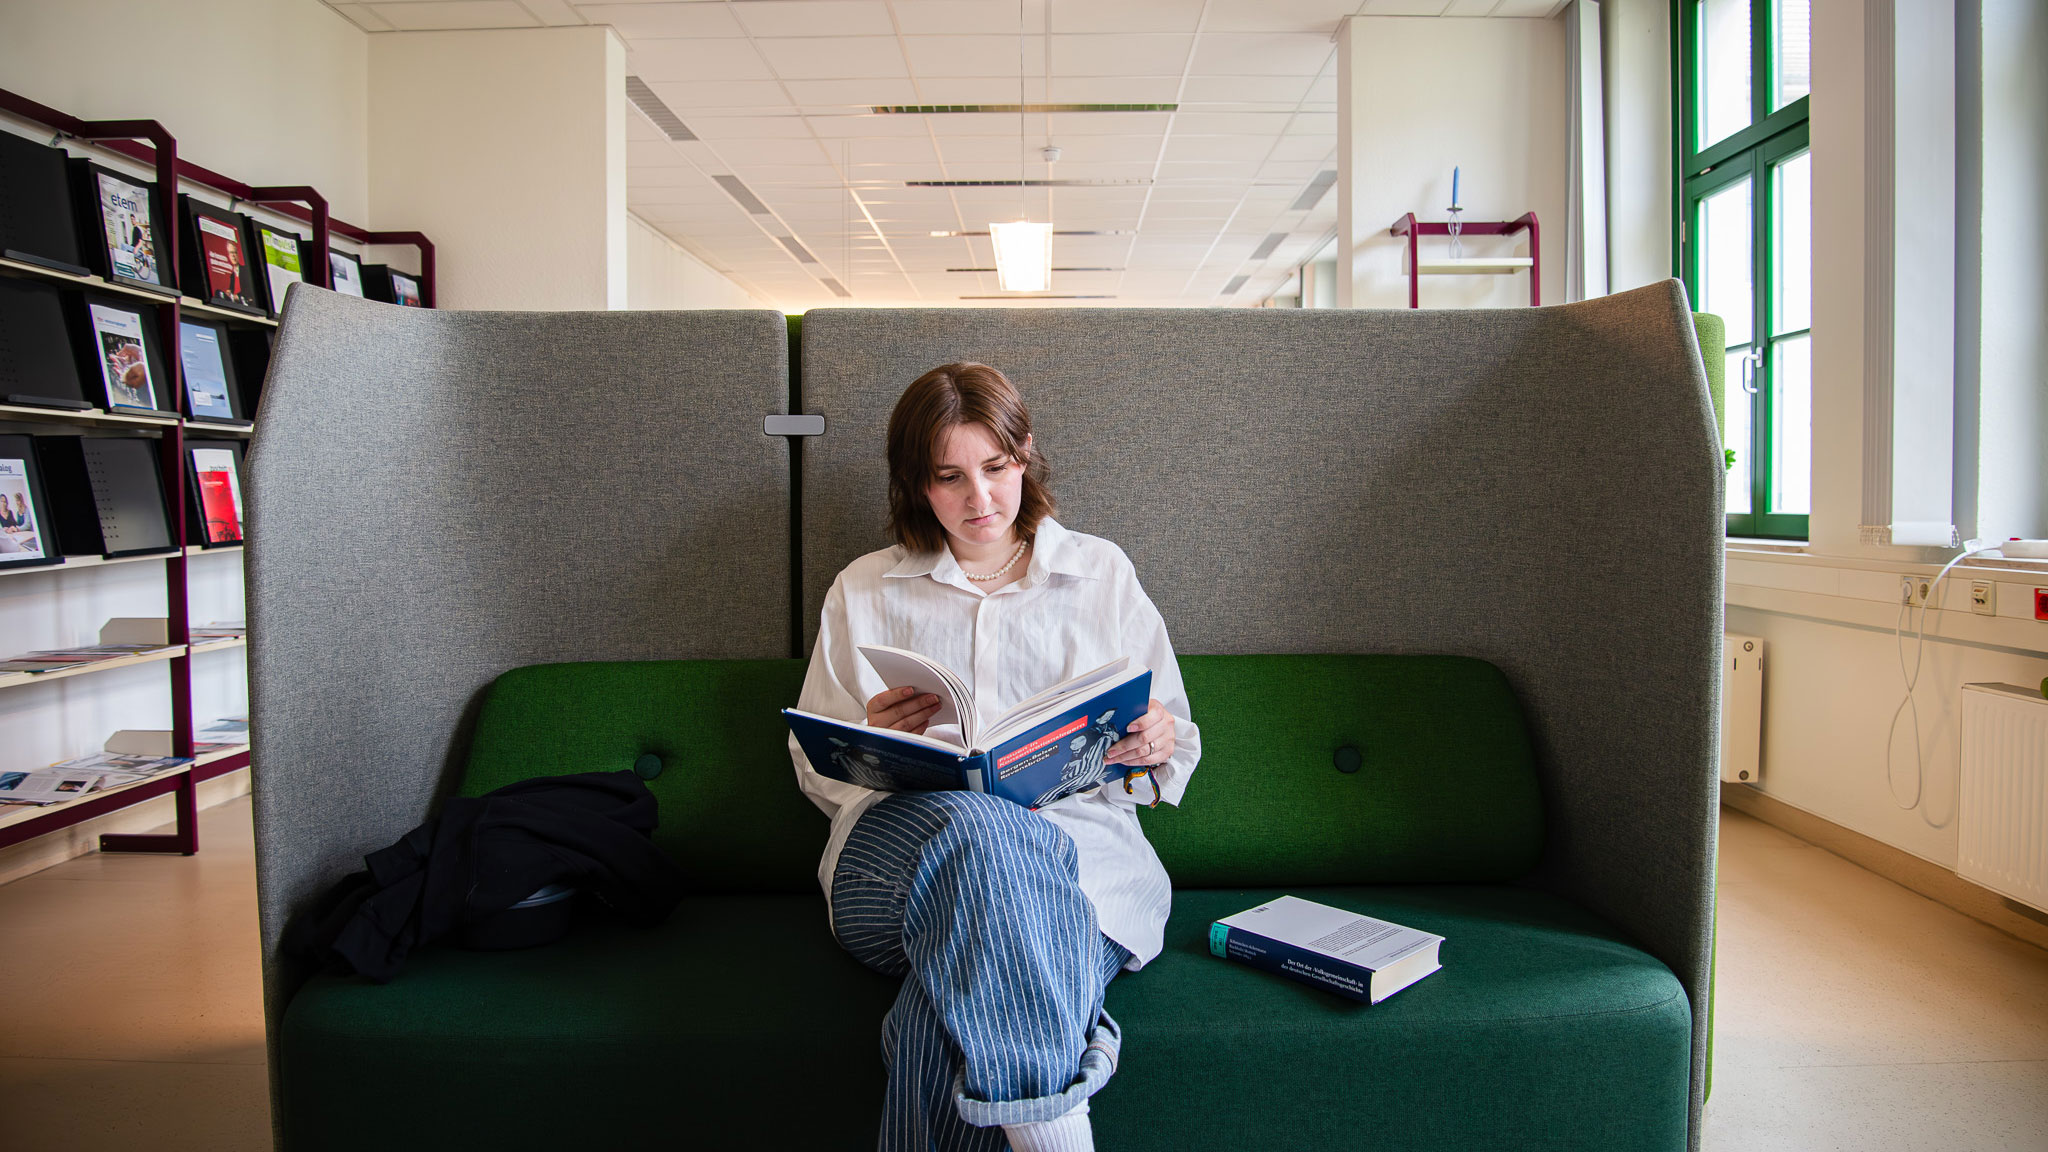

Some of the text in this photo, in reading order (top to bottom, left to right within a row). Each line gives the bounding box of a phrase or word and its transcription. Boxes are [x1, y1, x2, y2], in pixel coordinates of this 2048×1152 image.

[111, 193, 138, 212] etem
[999, 722, 1086, 767] Konzentrationslagern
[999, 740, 1038, 762] Frauen in
[1287, 958, 1296, 966] Der
[1296, 961, 1304, 969] Ort
